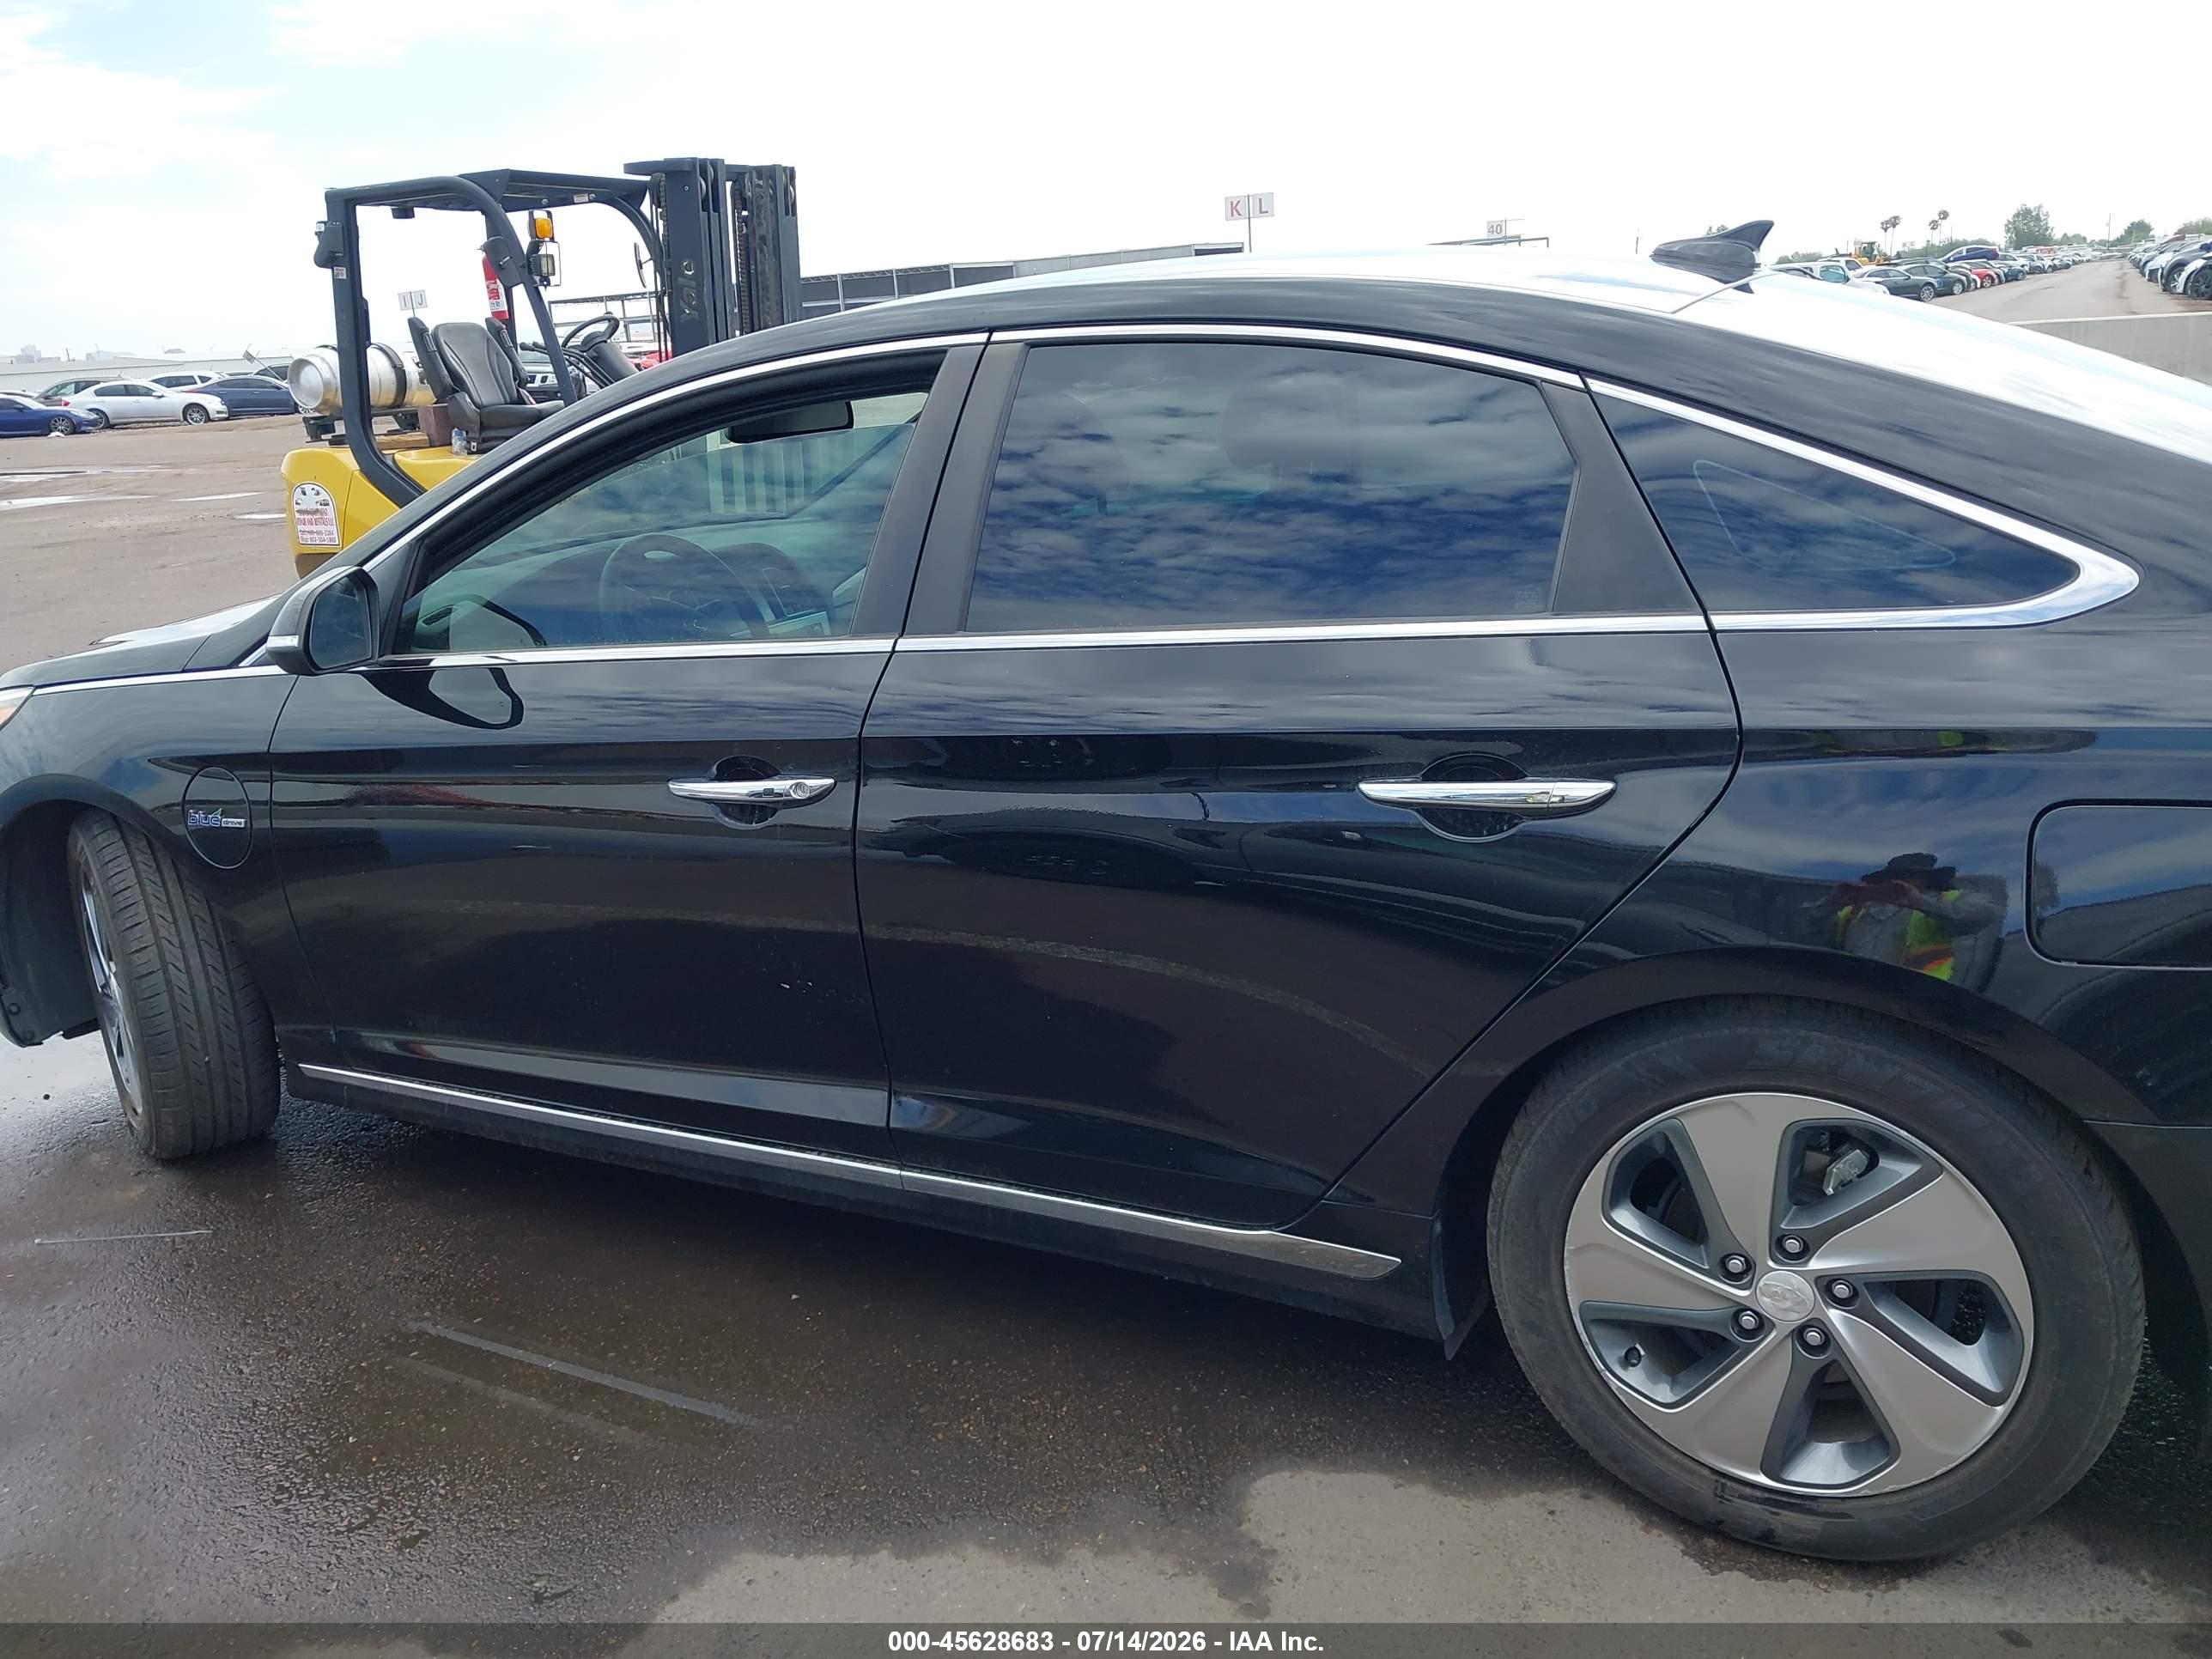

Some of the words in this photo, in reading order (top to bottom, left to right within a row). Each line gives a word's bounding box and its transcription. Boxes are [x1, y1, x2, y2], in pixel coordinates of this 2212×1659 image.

[1230, 200, 1243, 217] K
[1258, 198, 1269, 214] L
[1487, 223, 1503, 234] 40
[417, 293, 423, 306] J
[188, 810, 221, 826] blue
